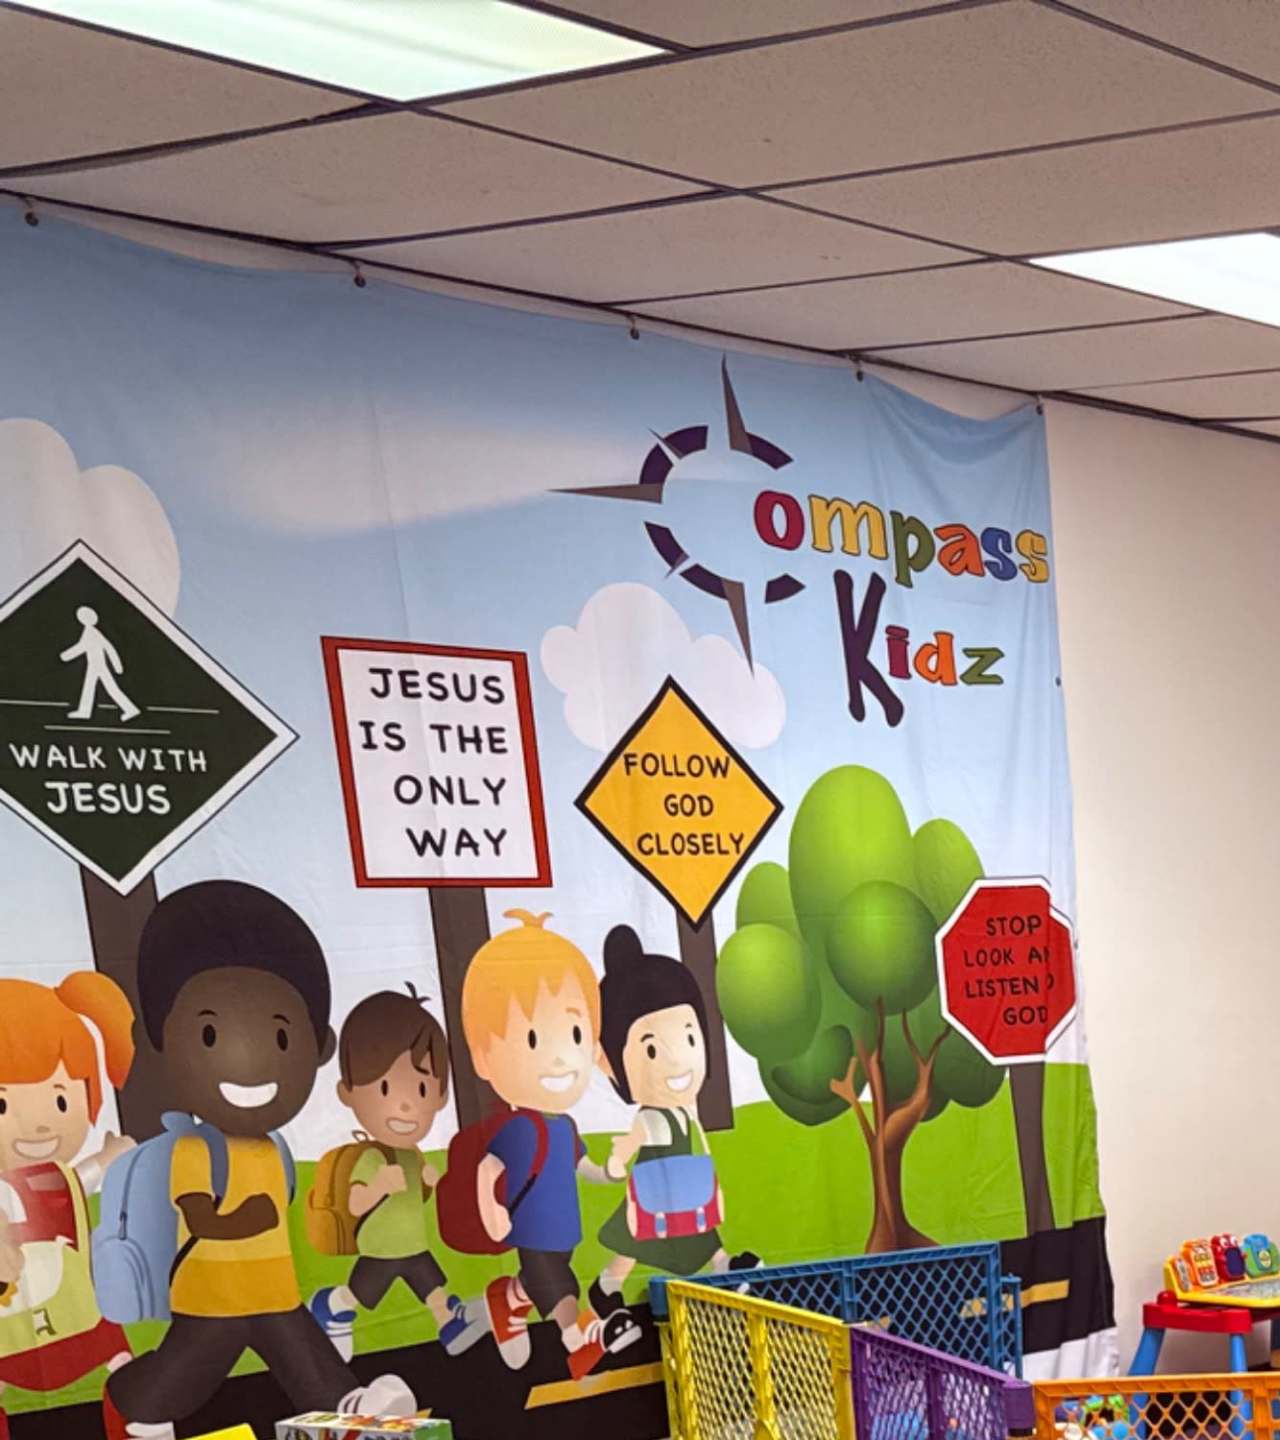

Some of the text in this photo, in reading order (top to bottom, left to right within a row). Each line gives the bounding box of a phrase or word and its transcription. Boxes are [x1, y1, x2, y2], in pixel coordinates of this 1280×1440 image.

[834, 569, 1004, 727] Kidz
[369, 668, 505, 704] JESUS
[359, 720, 508, 754] IS THE
[9, 744, 207, 772] WALK WITH
[624, 753, 730, 778] FOLLOW
[44, 782, 171, 814] JESUS
[394, 775, 506, 806] ONLY
[664, 794, 714, 817] GOD
[406, 828, 507, 857] WAY
[637, 832, 744, 856] CLOSELY
[986, 915, 1042, 936] STOP
[964, 947, 1015, 967] LOOK
[965, 976, 1039, 999] LISTEN
[1003, 1006, 1048, 1025] GOD
